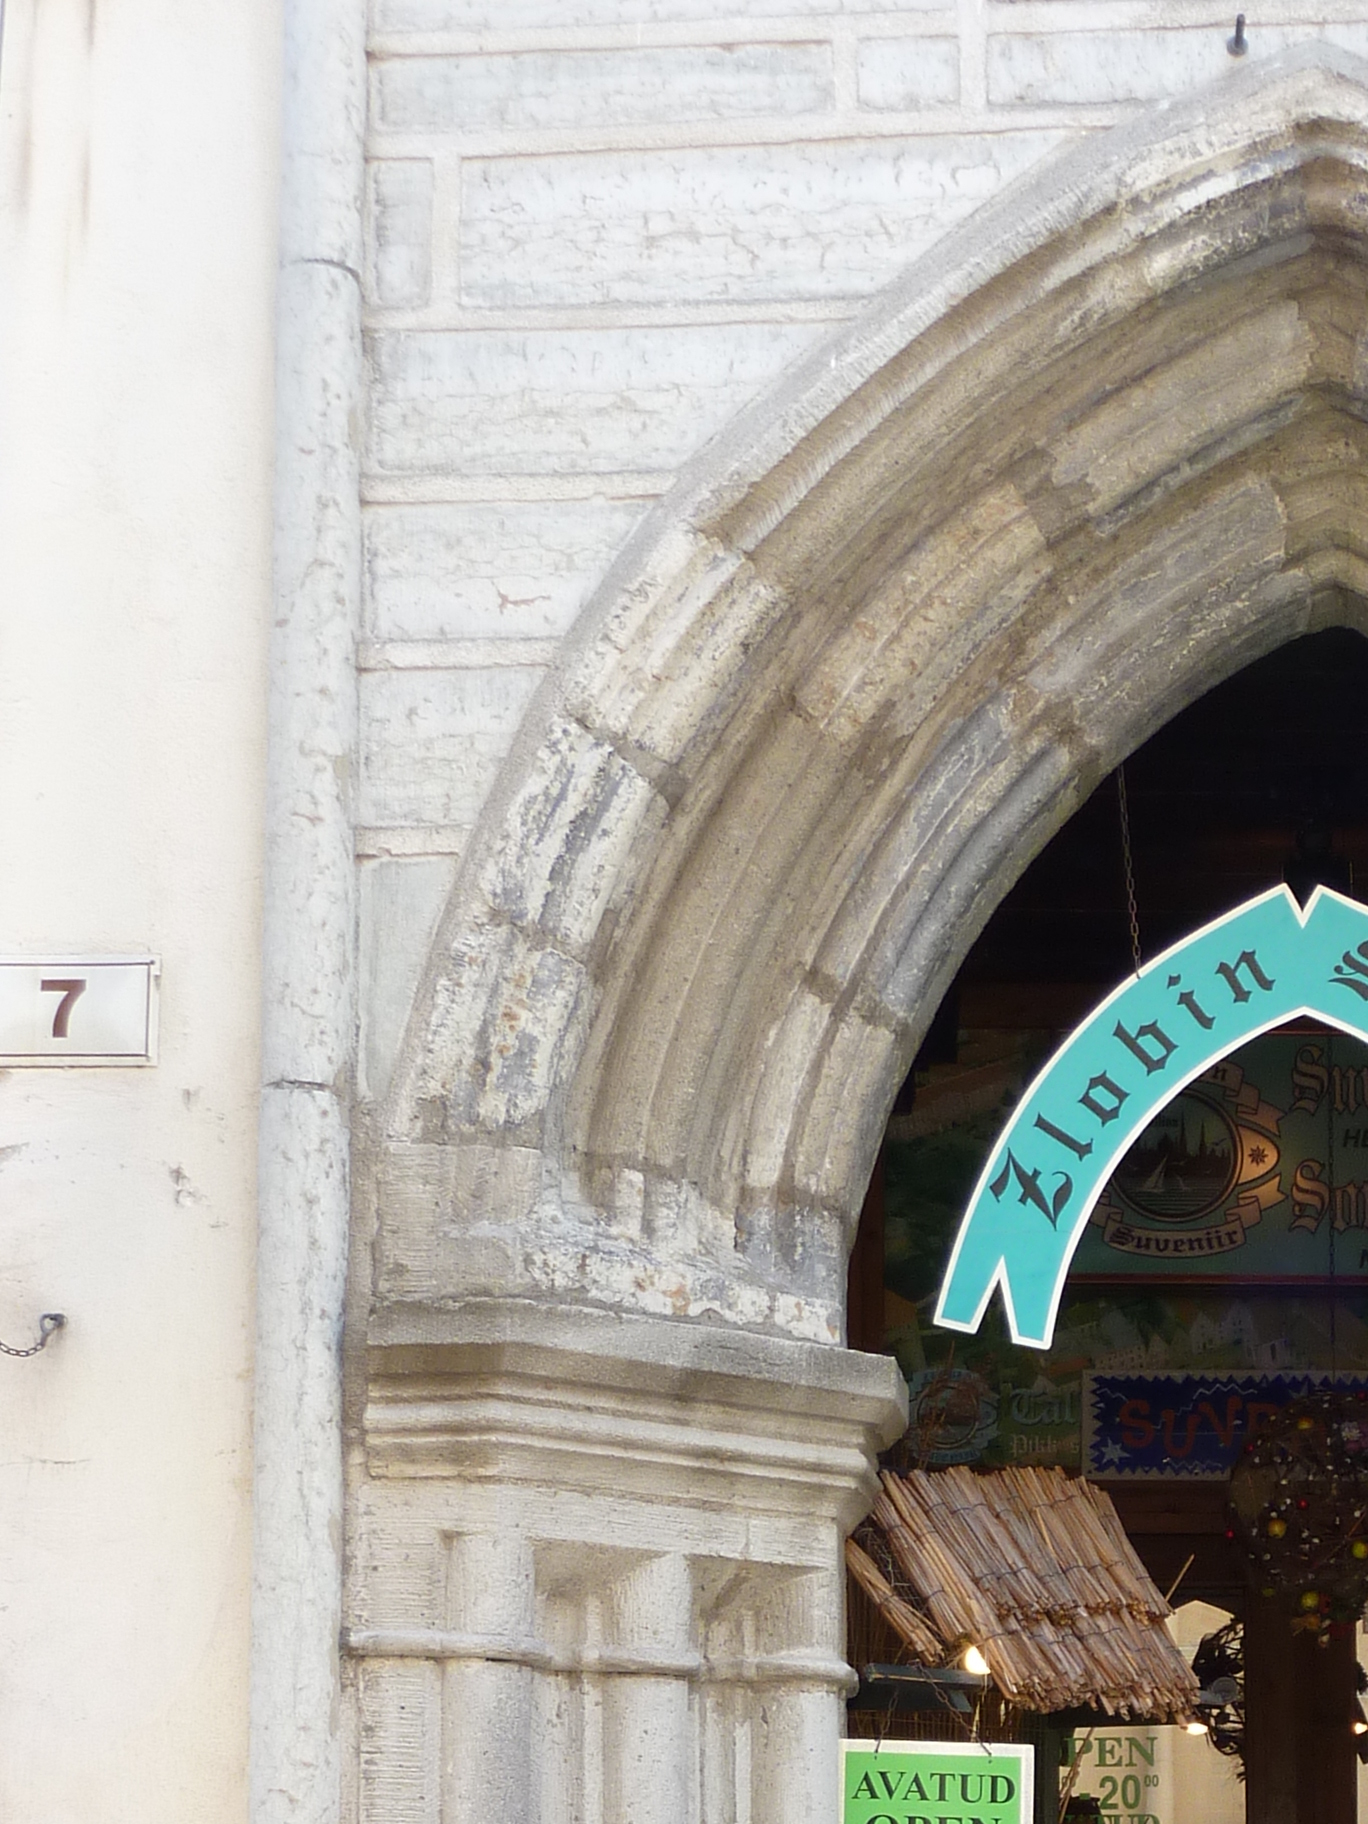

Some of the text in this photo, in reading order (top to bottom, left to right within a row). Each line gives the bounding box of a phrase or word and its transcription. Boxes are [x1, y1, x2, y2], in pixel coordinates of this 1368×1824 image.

[40, 978, 87, 1038] 7
[990, 948, 1277, 1232] Zlobin
[1109, 1225, 1239, 1253] Suveniir
[1059, 1736, 1159, 1767] PEN
[851, 1770, 1016, 1805] AVATUD
